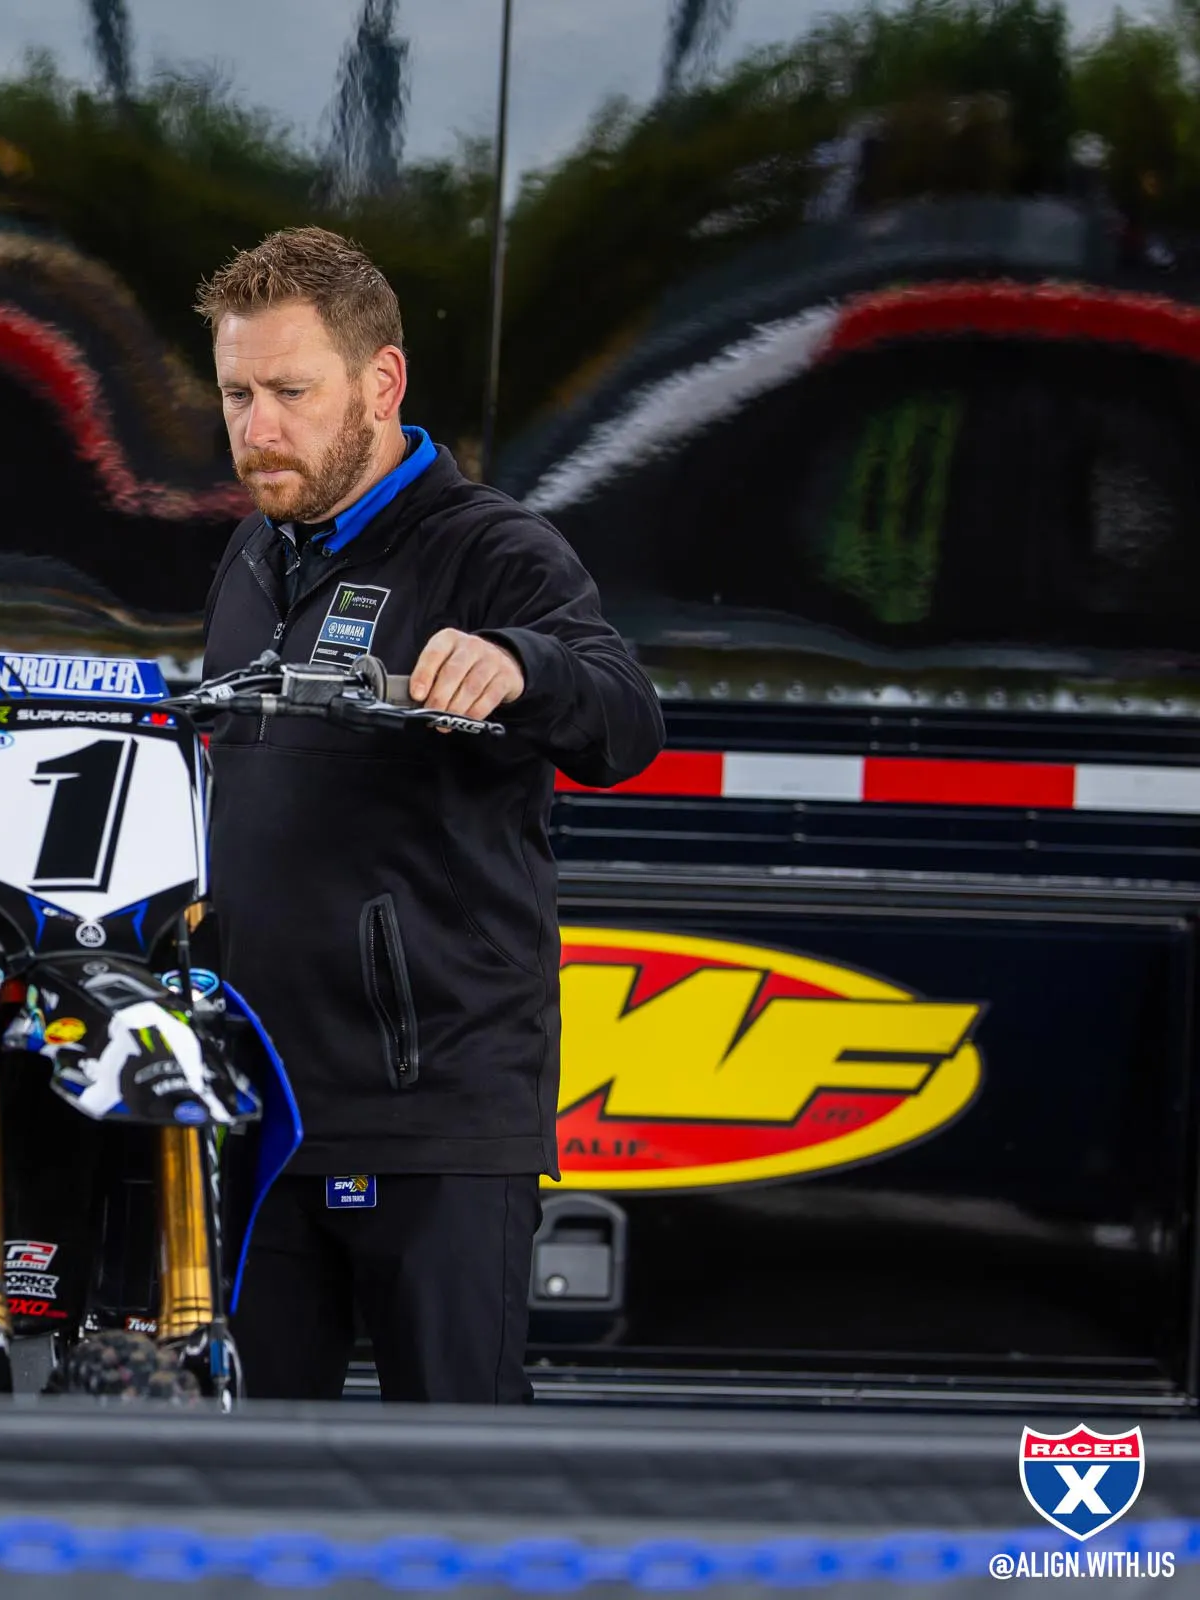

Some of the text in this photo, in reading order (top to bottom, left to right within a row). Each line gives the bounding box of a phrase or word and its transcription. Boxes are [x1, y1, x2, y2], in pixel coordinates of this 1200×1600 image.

[336, 623, 366, 638] YAMAHA
[2, 656, 136, 695] PROTAPER
[16, 709, 133, 724] SUPERCROSS
[27, 737, 139, 894] 1
[558, 961, 989, 1128] MF
